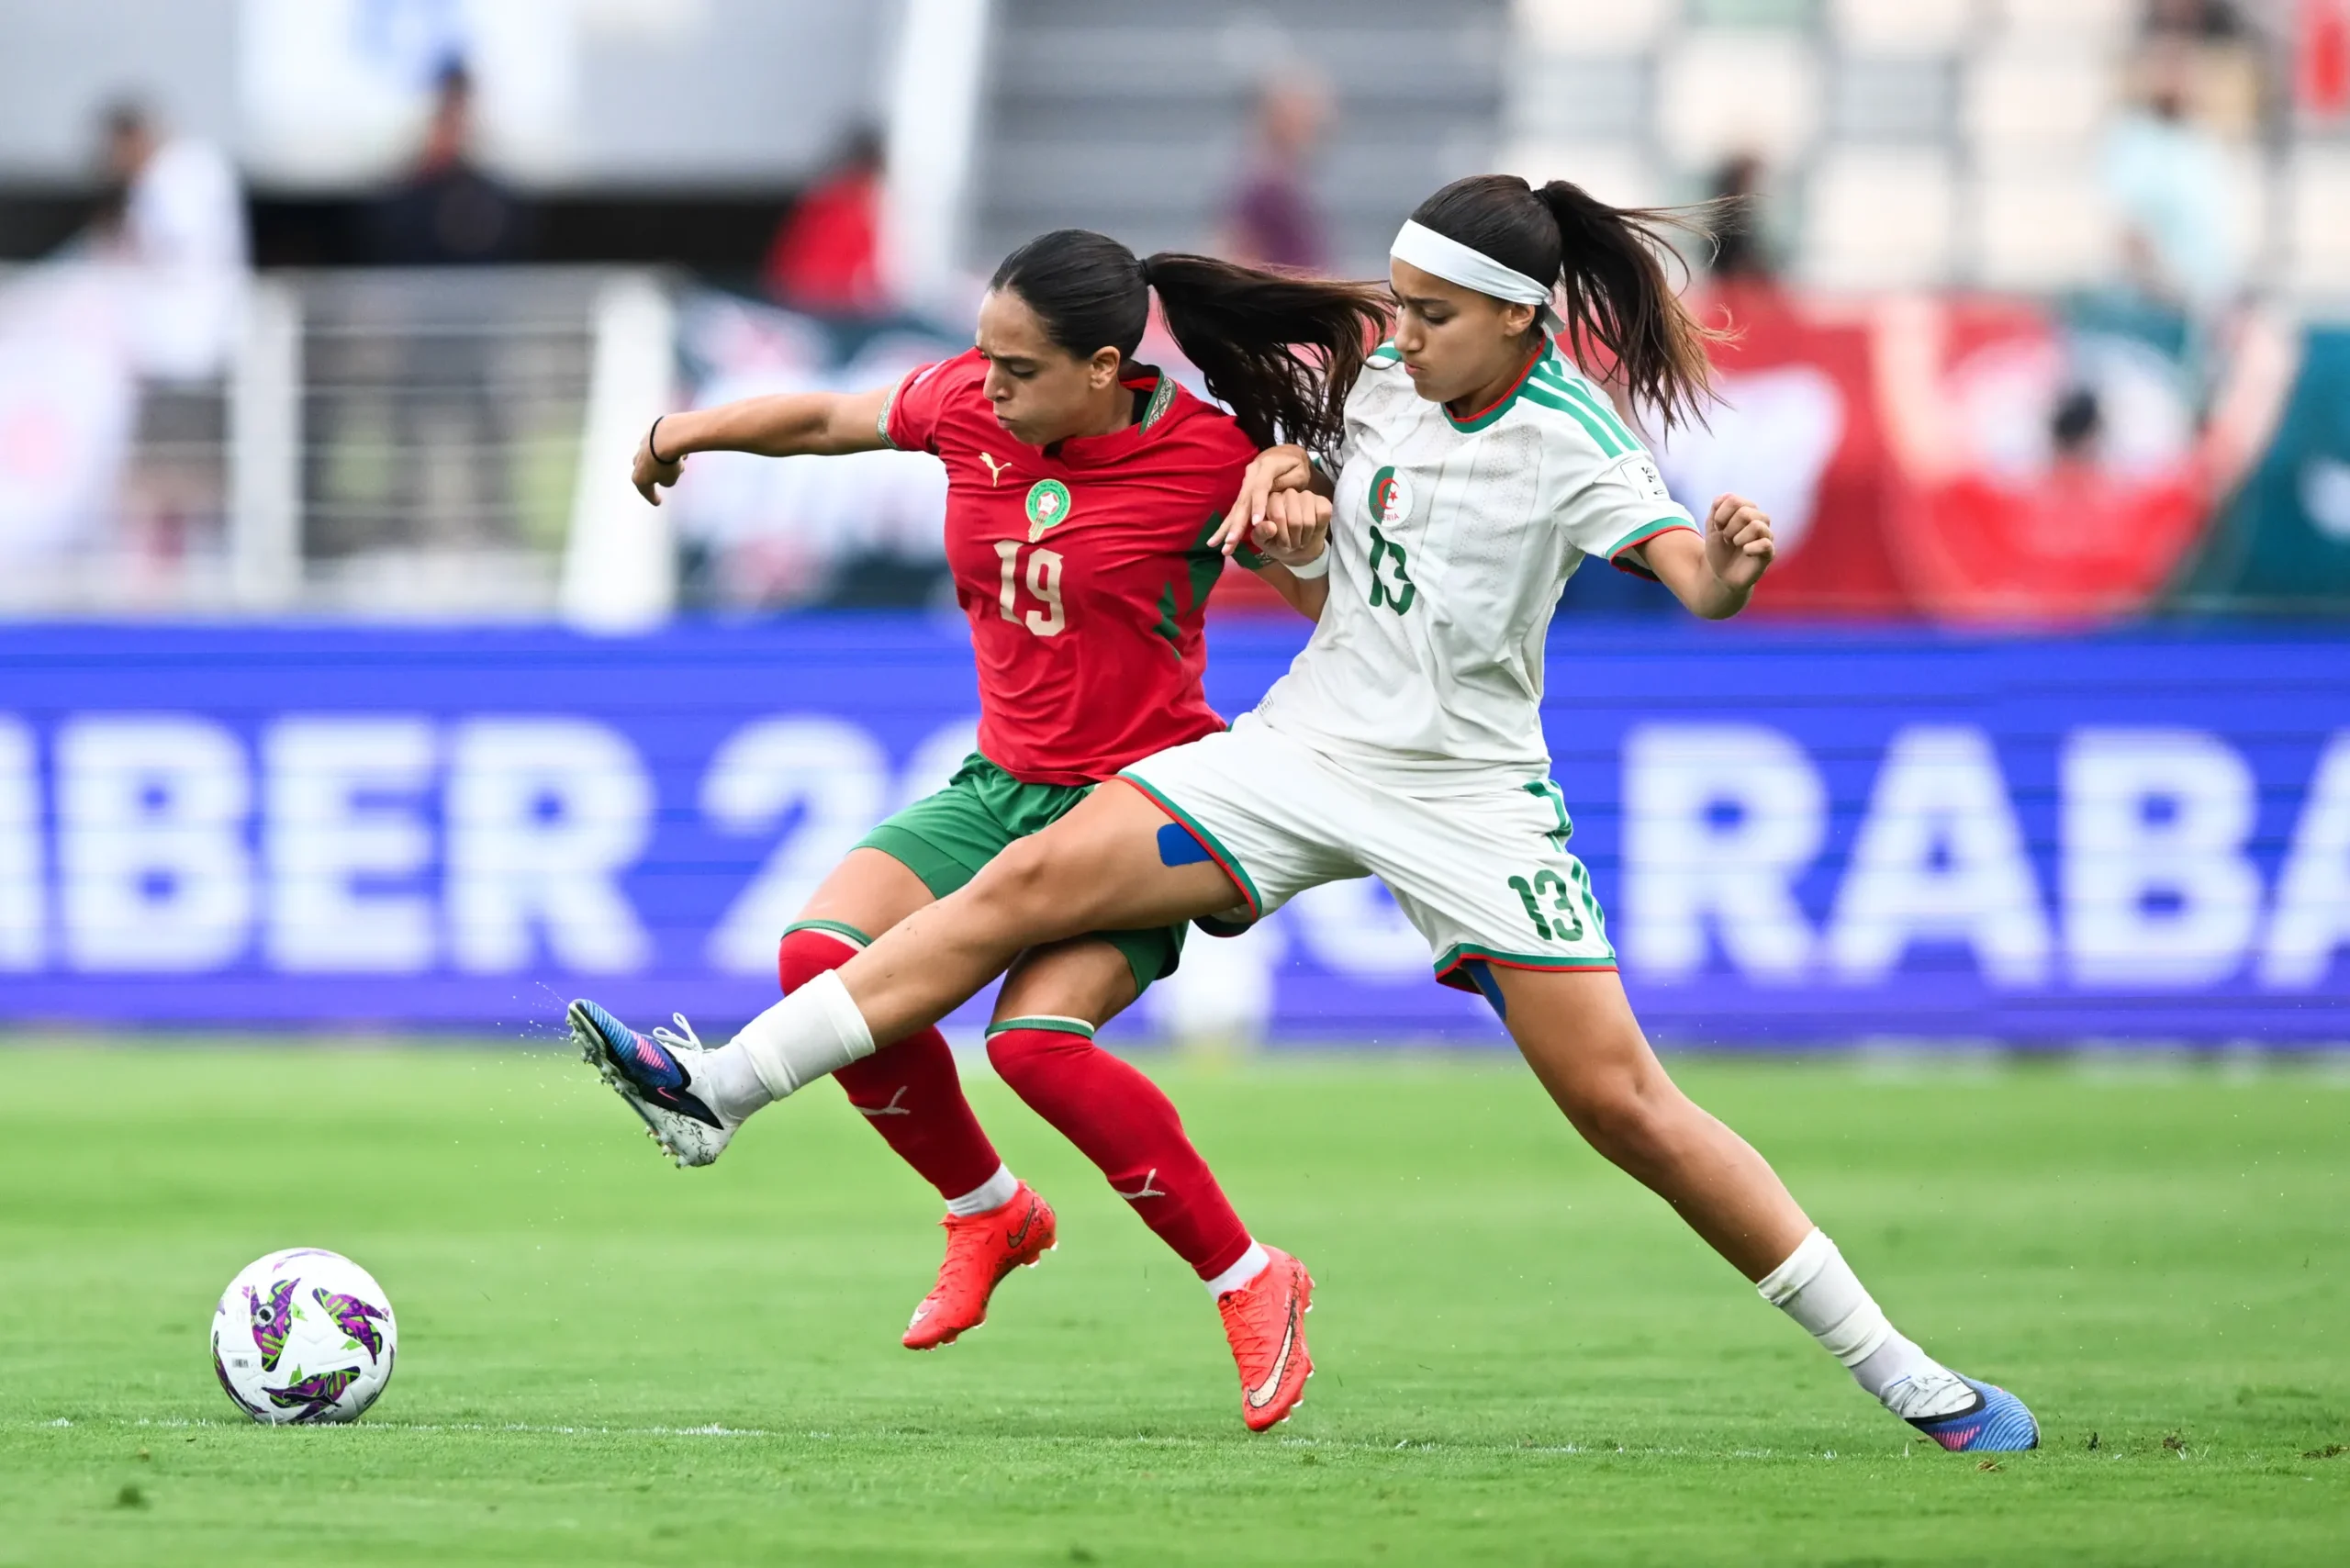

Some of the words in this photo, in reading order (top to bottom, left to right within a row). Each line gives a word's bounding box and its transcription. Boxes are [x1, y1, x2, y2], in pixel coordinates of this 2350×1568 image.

[993, 539, 1066, 637] 19
[1369, 524, 1416, 616] 13
[1507, 868, 1584, 942] 13
